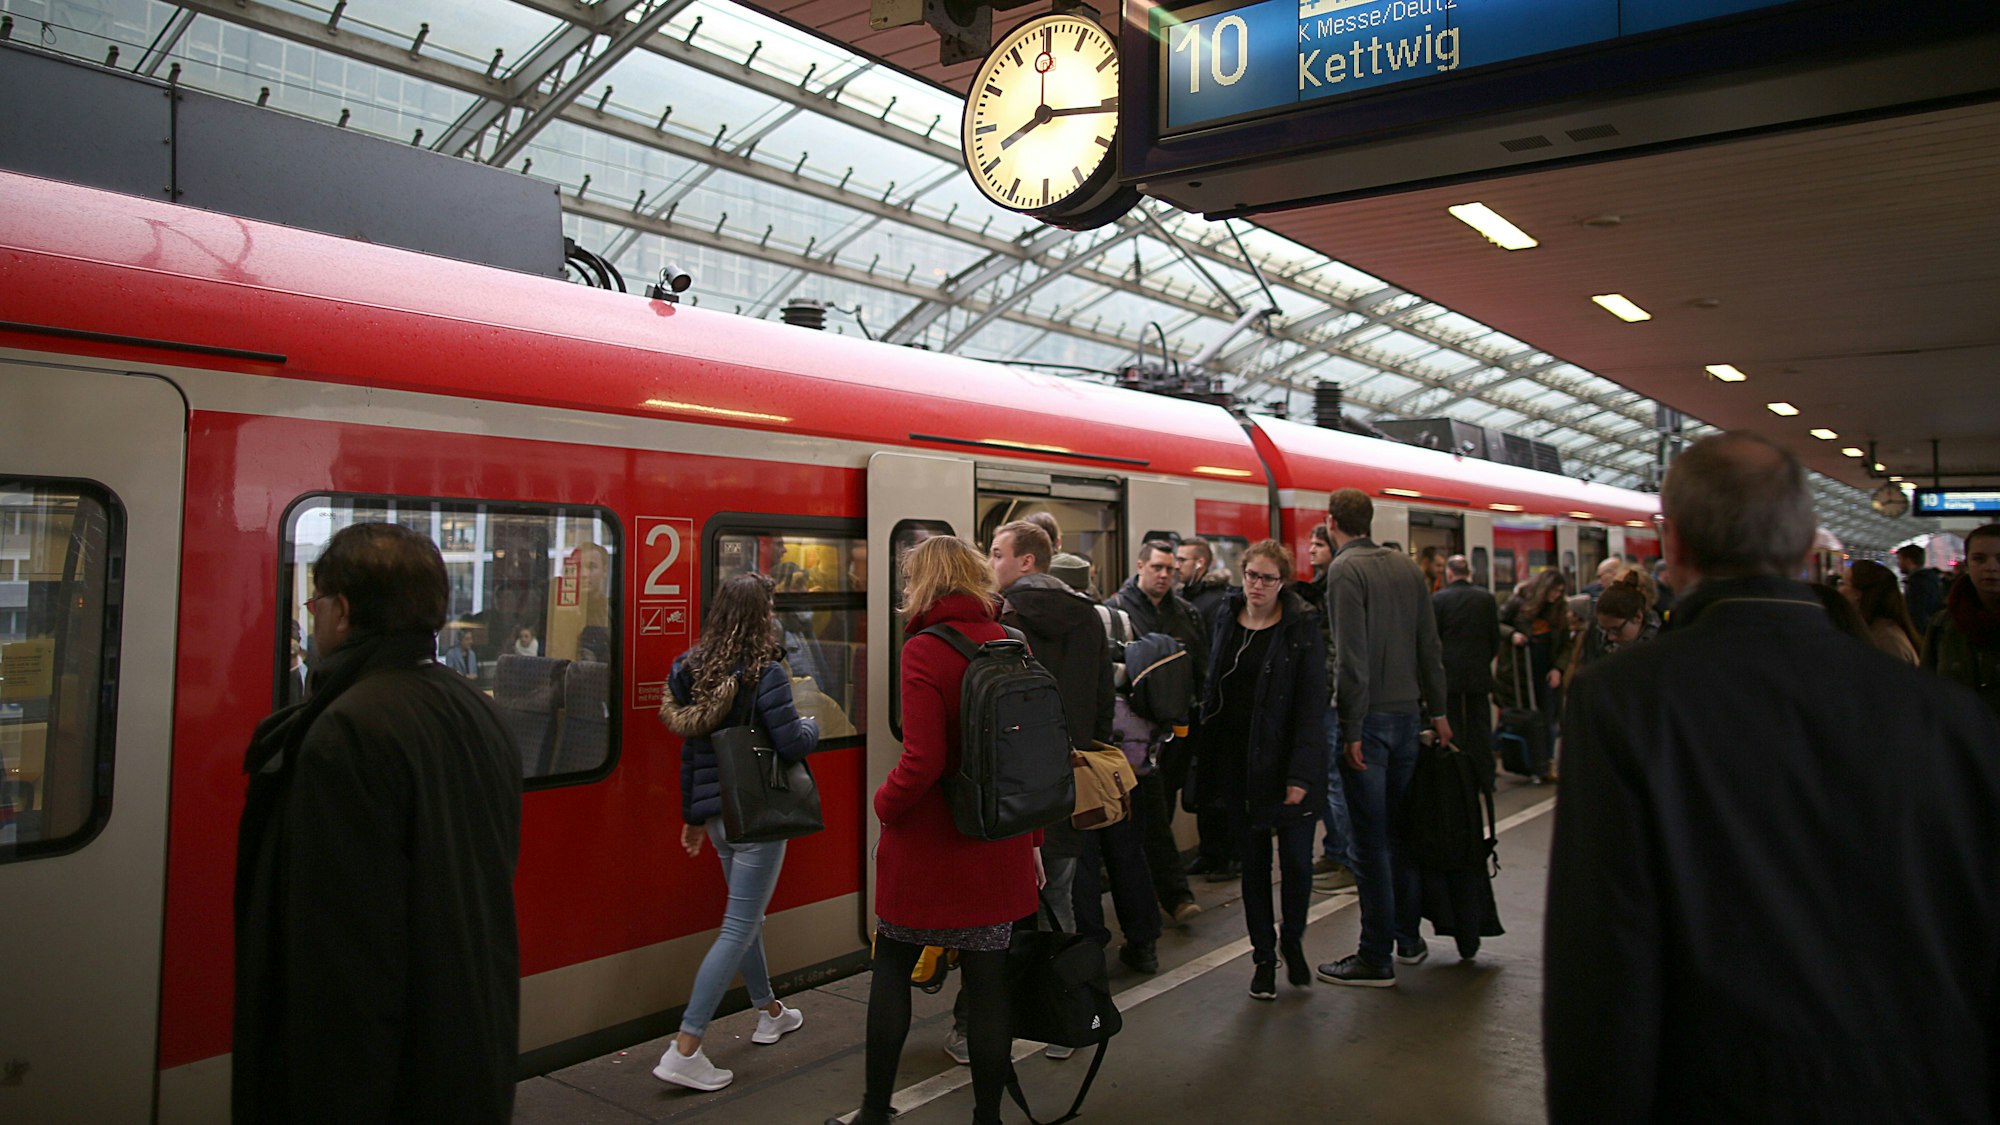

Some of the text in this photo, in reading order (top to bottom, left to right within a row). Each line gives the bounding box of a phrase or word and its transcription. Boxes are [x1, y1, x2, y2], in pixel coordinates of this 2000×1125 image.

[1175, 14, 1248, 94] 10
[1299, 22, 1311, 43] K
[1299, 24, 1460, 90] Kettwig
[1921, 493, 1938, 506] 10
[644, 524, 680, 595] 2
